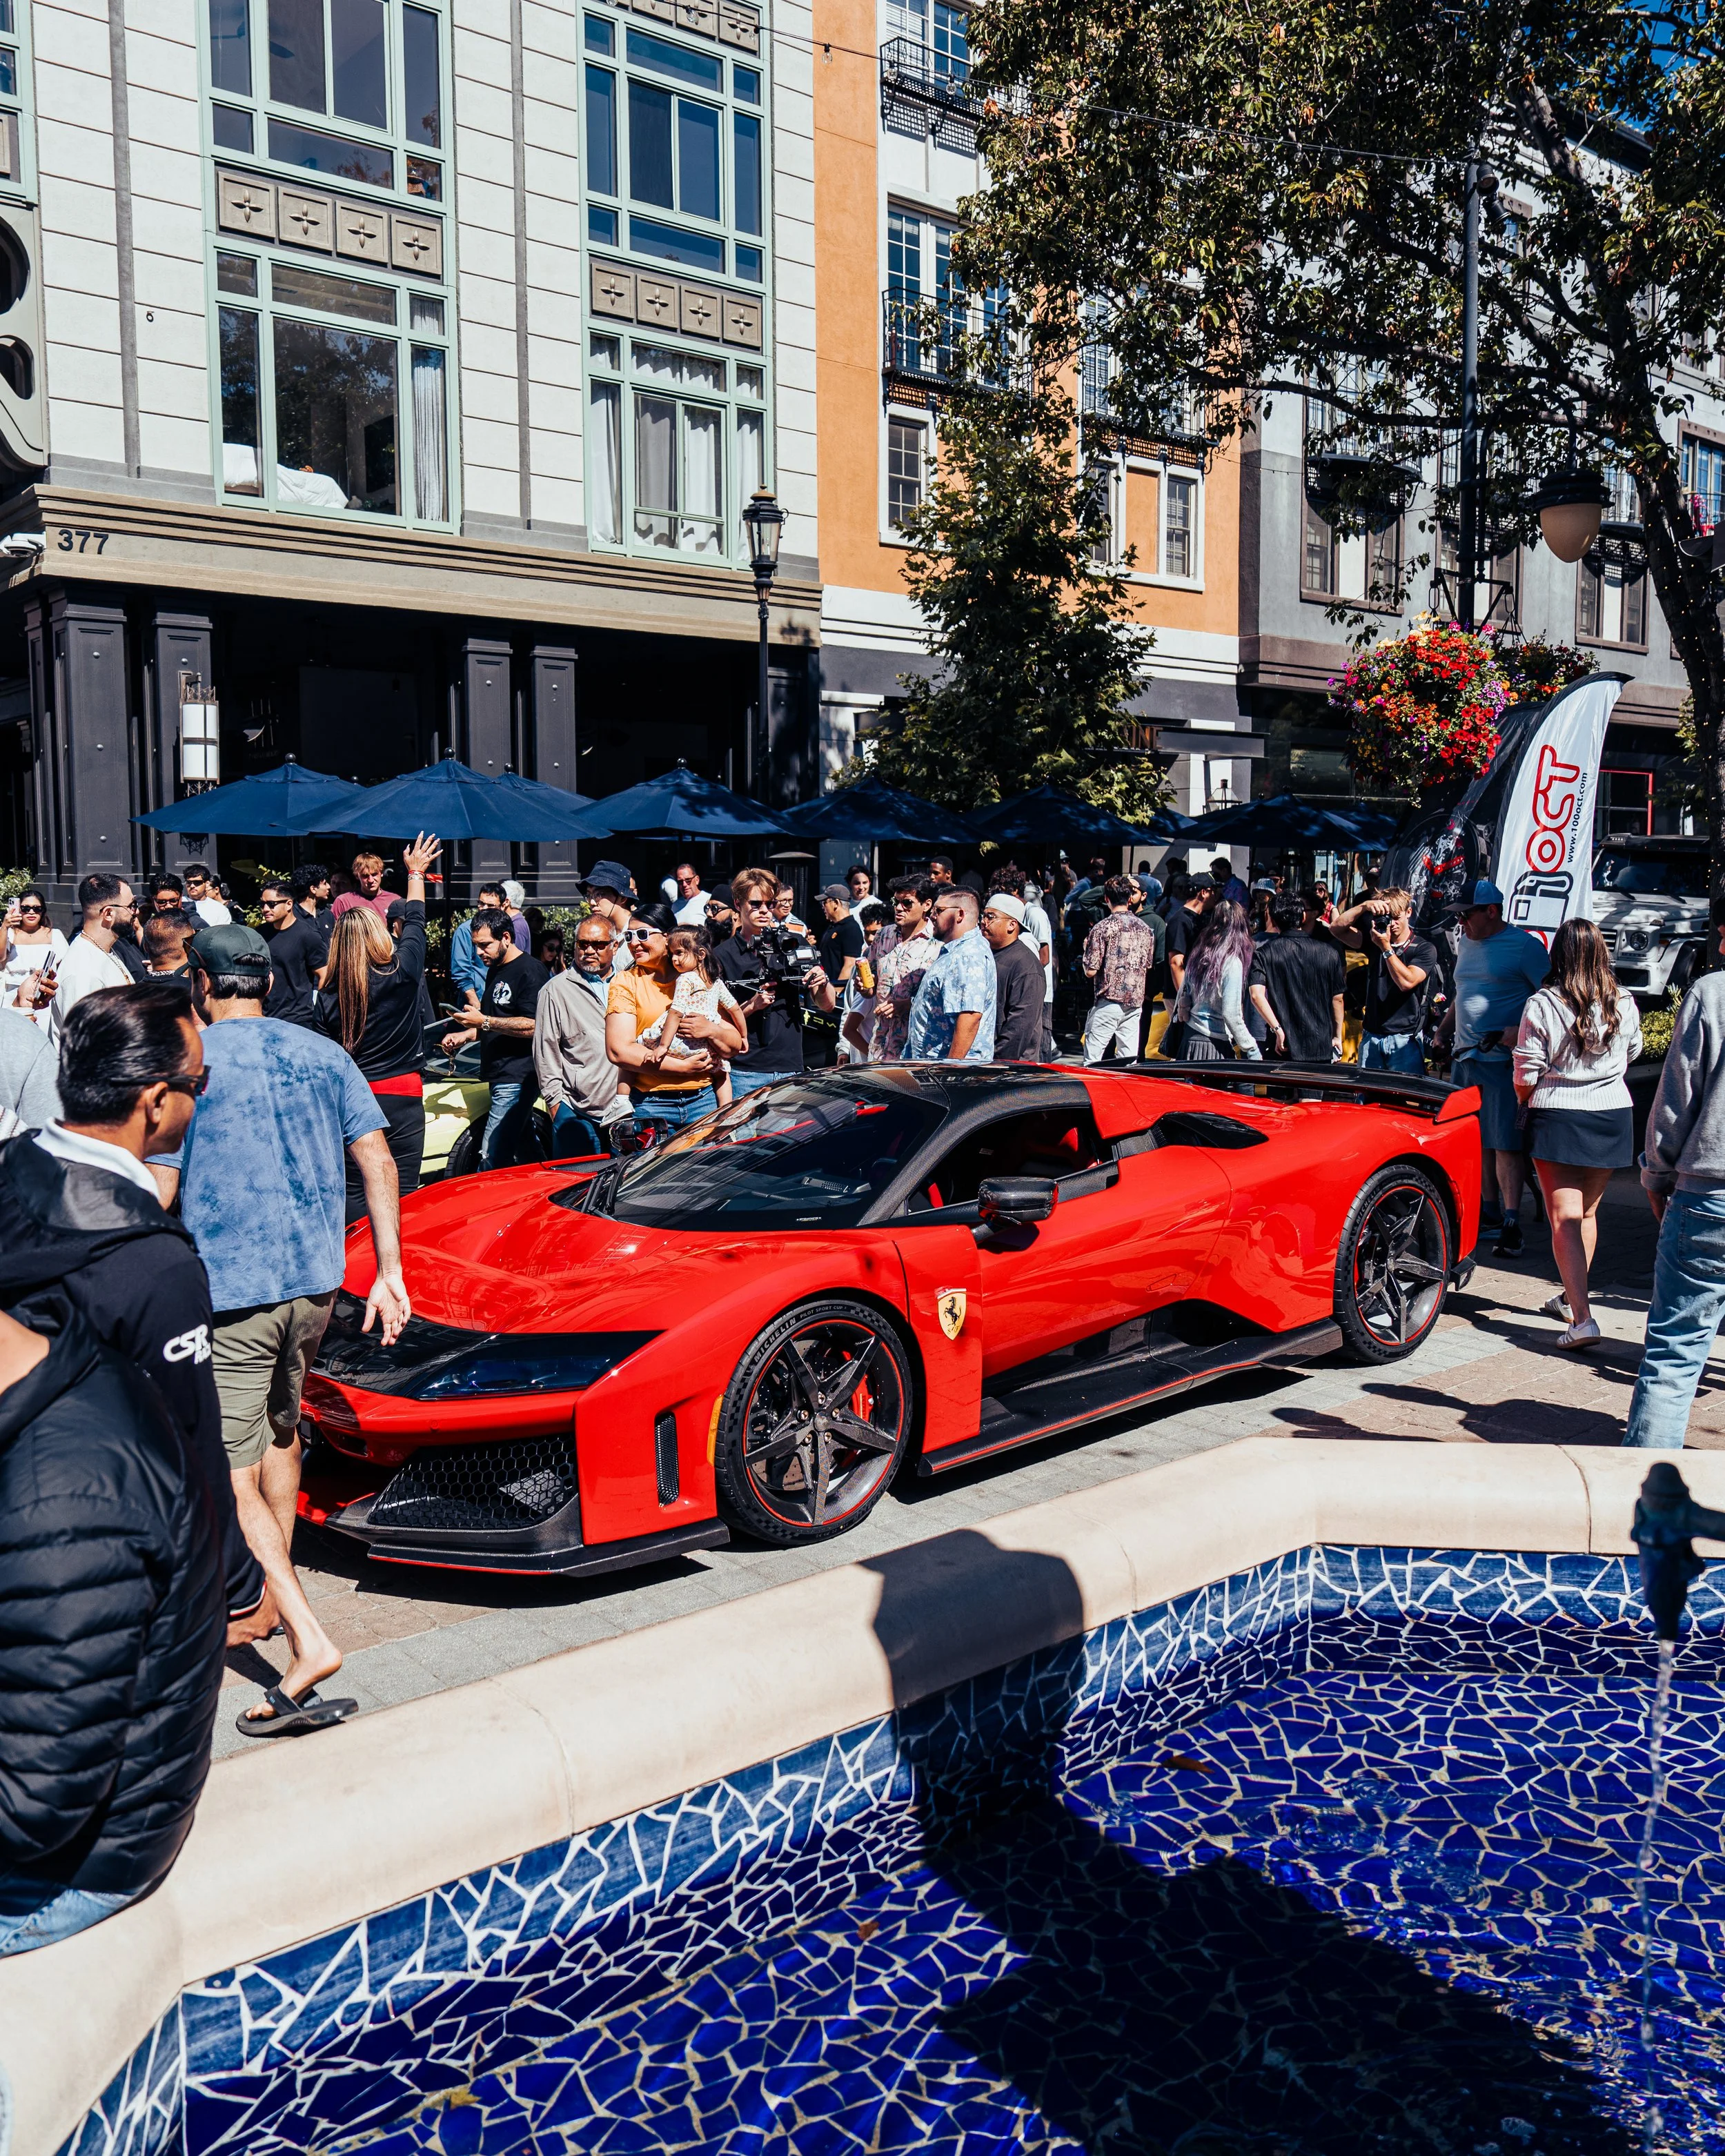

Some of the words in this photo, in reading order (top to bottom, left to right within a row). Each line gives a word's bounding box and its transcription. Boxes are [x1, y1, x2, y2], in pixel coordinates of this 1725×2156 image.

[57, 528, 109, 555] 377
[1568, 772, 1588, 863] www.100oct.com
[1355, 1185, 1381, 1225] MICHELIN
[163, 1324, 208, 1362] CSR
[753, 1317, 796, 1363] MICHELIN
[800, 1309, 814, 1318] PILOT
